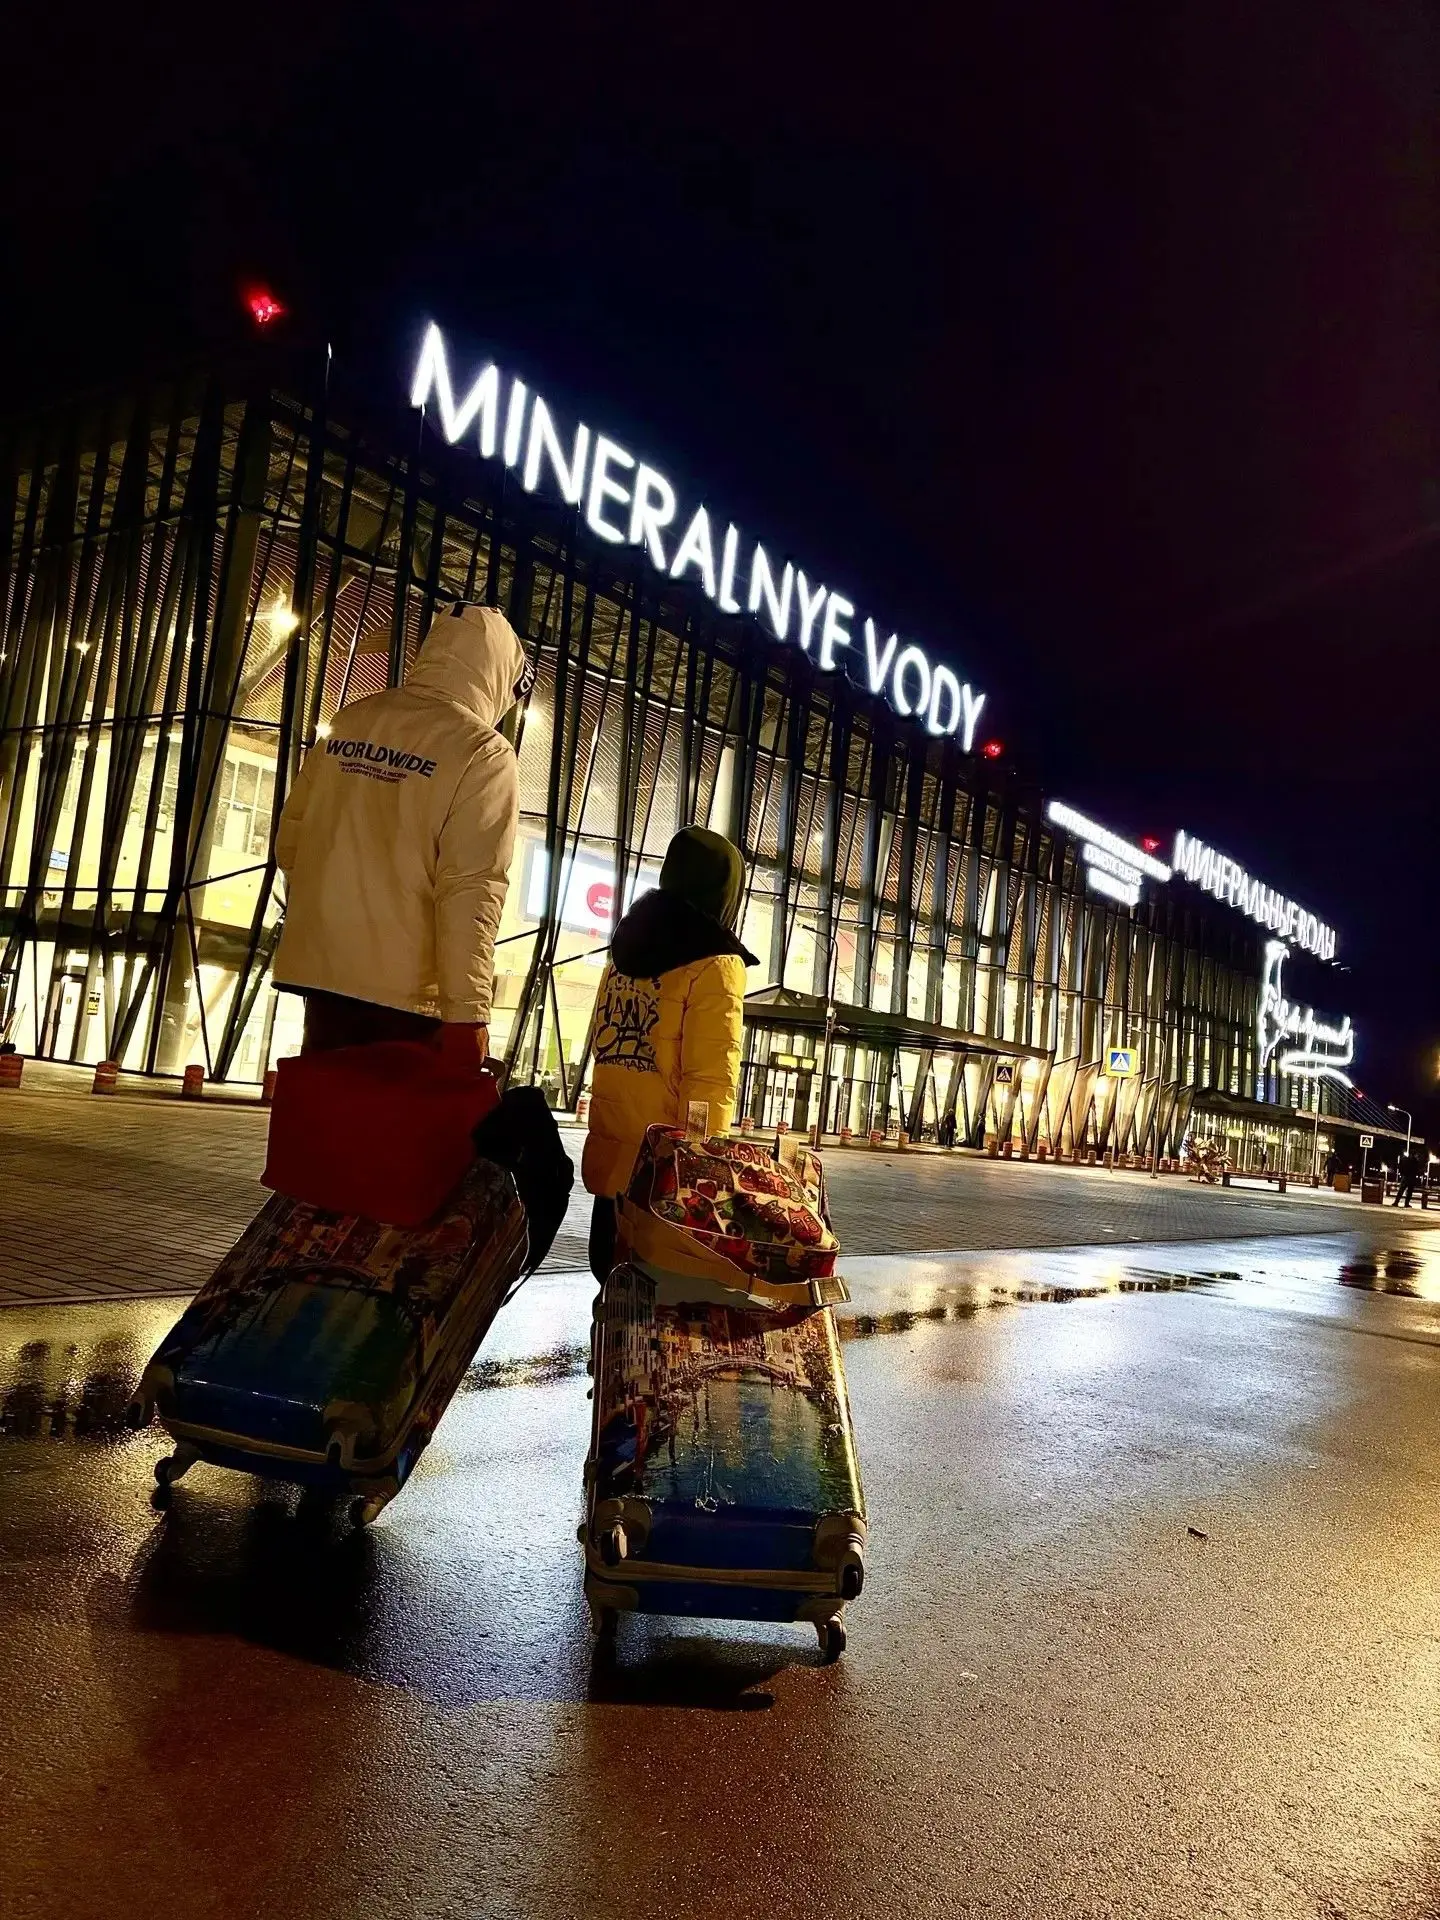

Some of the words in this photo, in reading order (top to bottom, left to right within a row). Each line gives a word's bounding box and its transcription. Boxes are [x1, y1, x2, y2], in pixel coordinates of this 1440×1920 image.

[411, 320, 854, 671] MINERALNYE
[866, 616, 986, 755] VODY
[325, 739, 437, 778] WORLDWIDE
[1172, 828, 1301, 940] МИНЕРАЛЬНЫЕ
